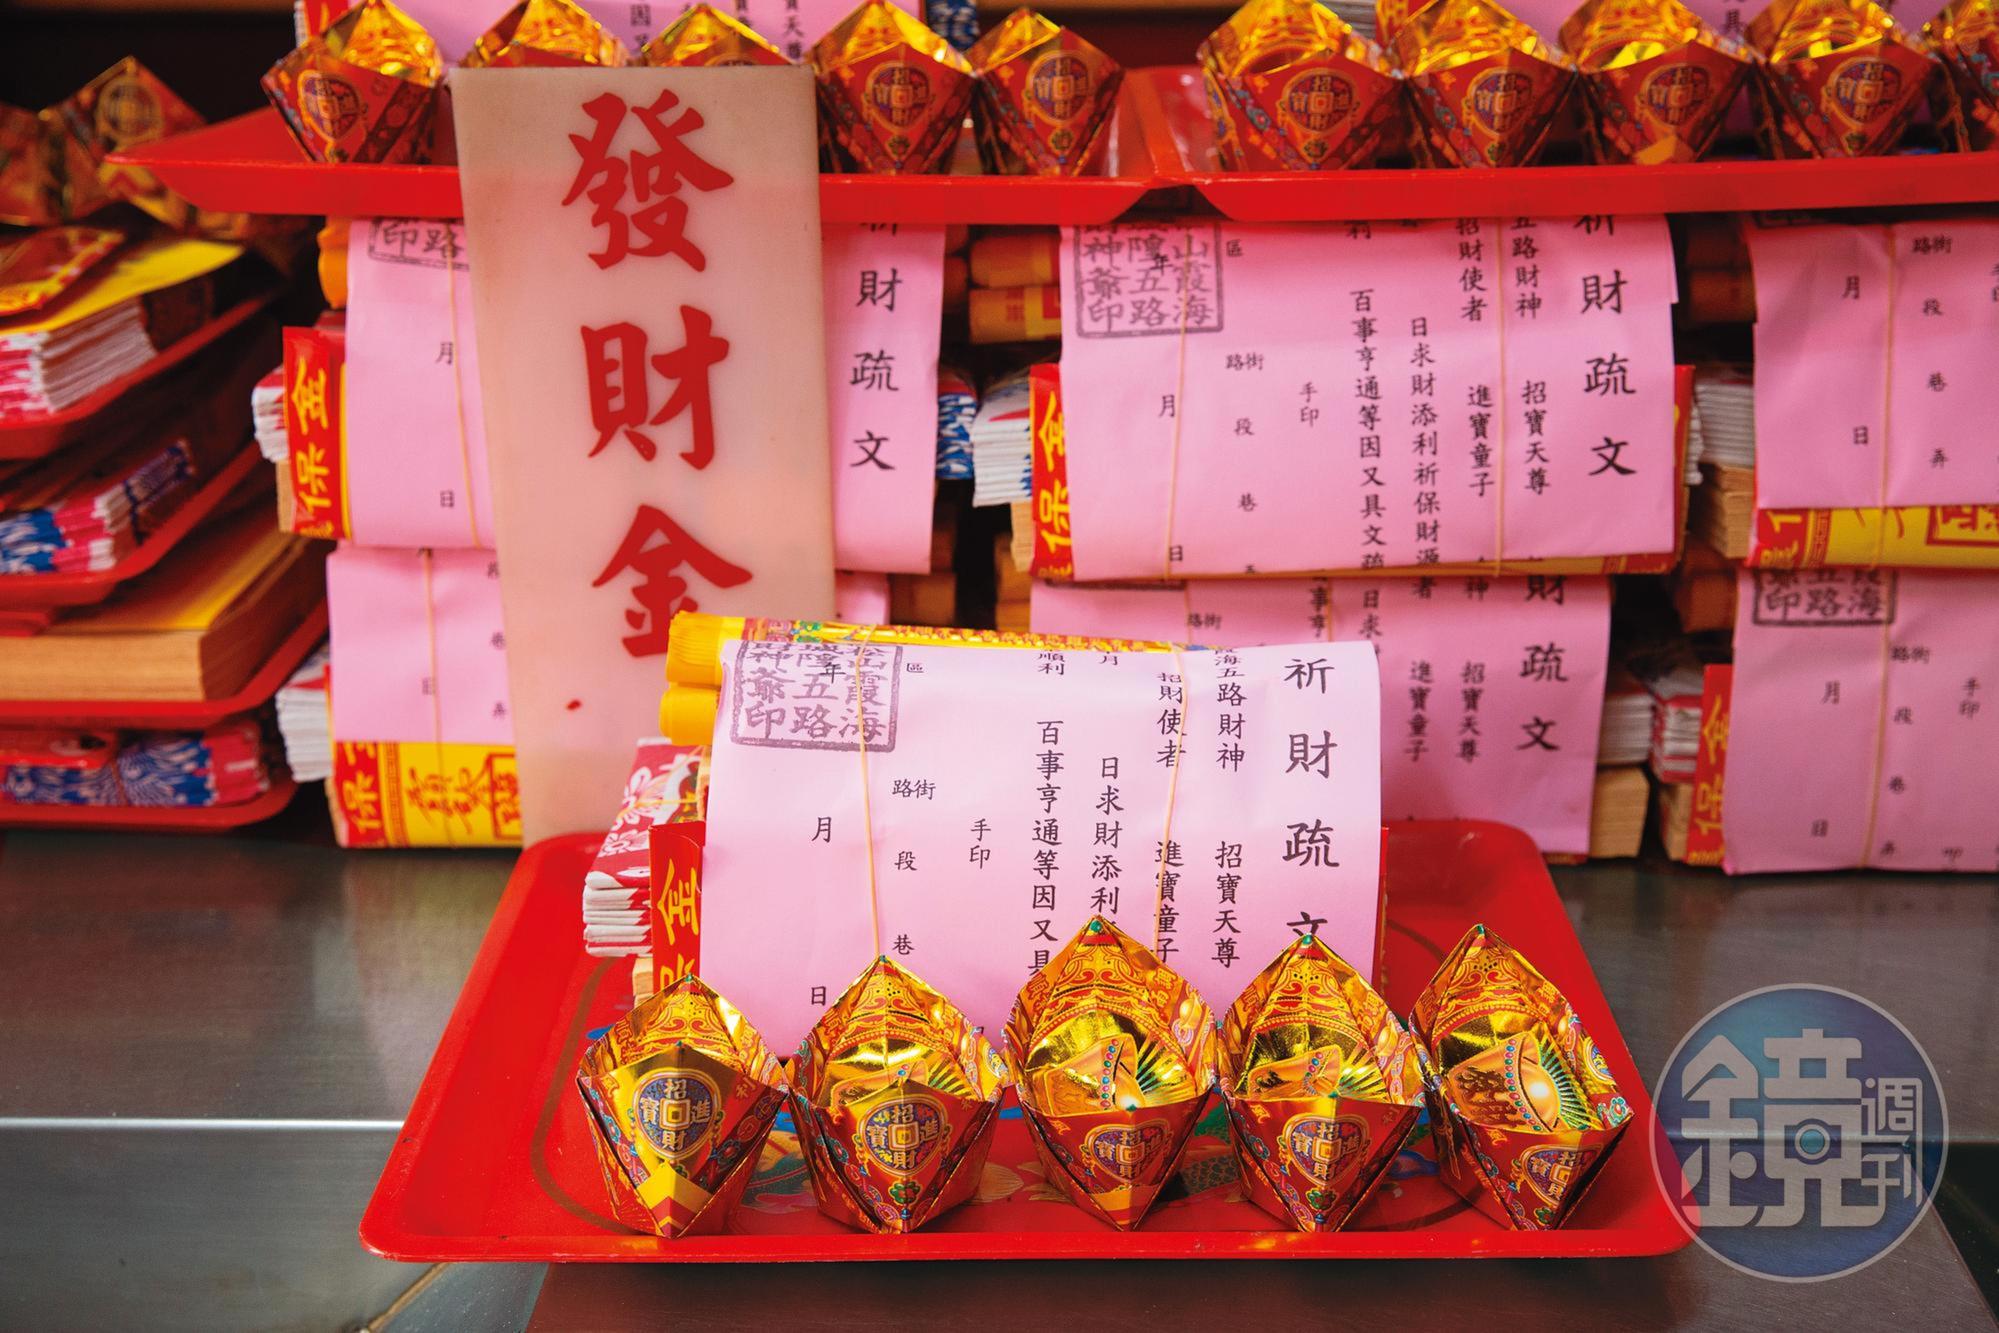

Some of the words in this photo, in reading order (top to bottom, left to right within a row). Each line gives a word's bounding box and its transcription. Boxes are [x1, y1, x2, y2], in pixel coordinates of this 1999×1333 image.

[435, 341, 454, 365] 月
[562, 88, 754, 659] 發財金
[1467, 384, 1495, 497] 進寶童子
[1521, 379, 1550, 495] 招寶天尊
[1159, 394, 1176, 418] 月
[1169, 545, 1184, 562] 日
[439, 490, 455, 508] 日
[820, 662, 846, 684] 年
[811, 817, 833, 843] 月
[968, 818, 992, 869] 手印
[1090, 757, 1125, 926] 日求財添利
[894, 850, 918, 872] 段
[1211, 840, 1244, 969] 招寶天尊
[891, 934, 915, 956] 巷
[811, 985, 828, 1007] 日
